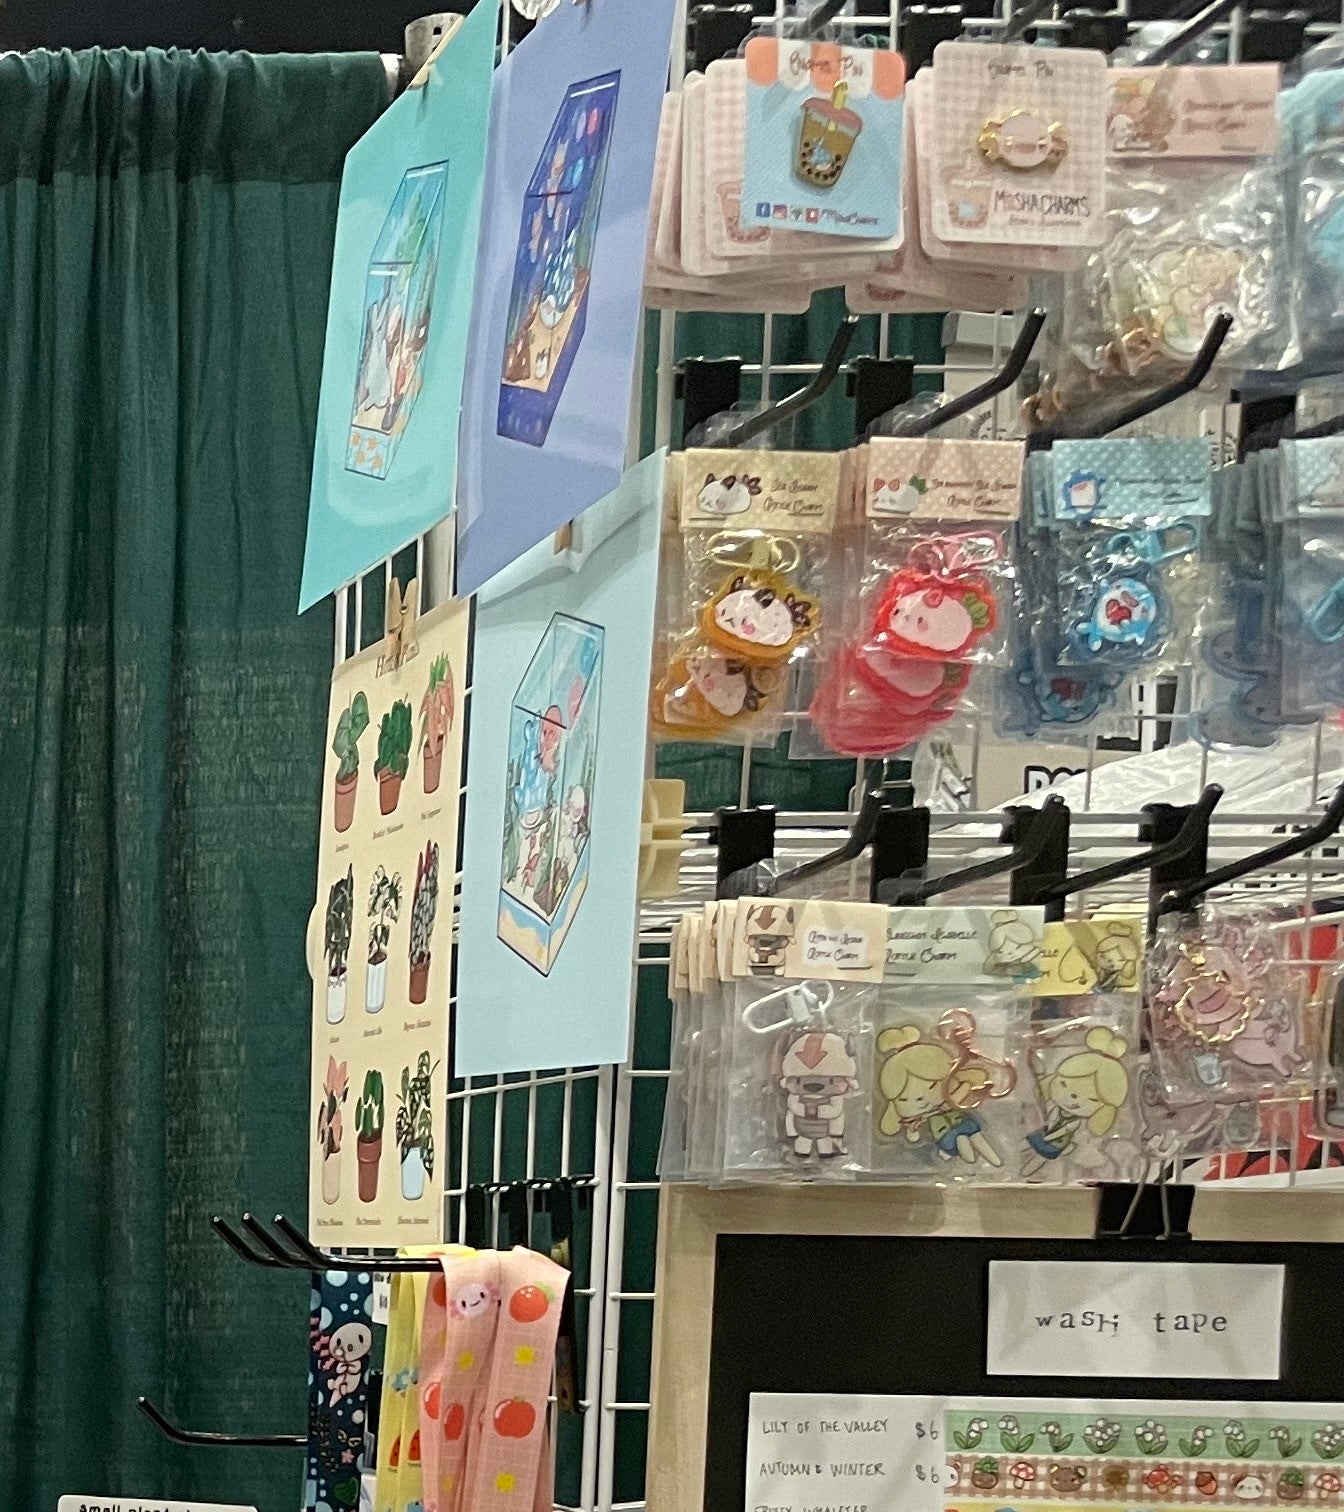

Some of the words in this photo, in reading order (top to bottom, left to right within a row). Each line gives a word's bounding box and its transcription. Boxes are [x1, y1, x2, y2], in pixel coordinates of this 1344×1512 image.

[1152, 1312, 1227, 1334] tape
[797, 1421, 810, 1434] OF
[819, 1420, 841, 1432] THE
[844, 1417, 889, 1433] VALLEY
[830, 1462, 885, 1477] WINTER
